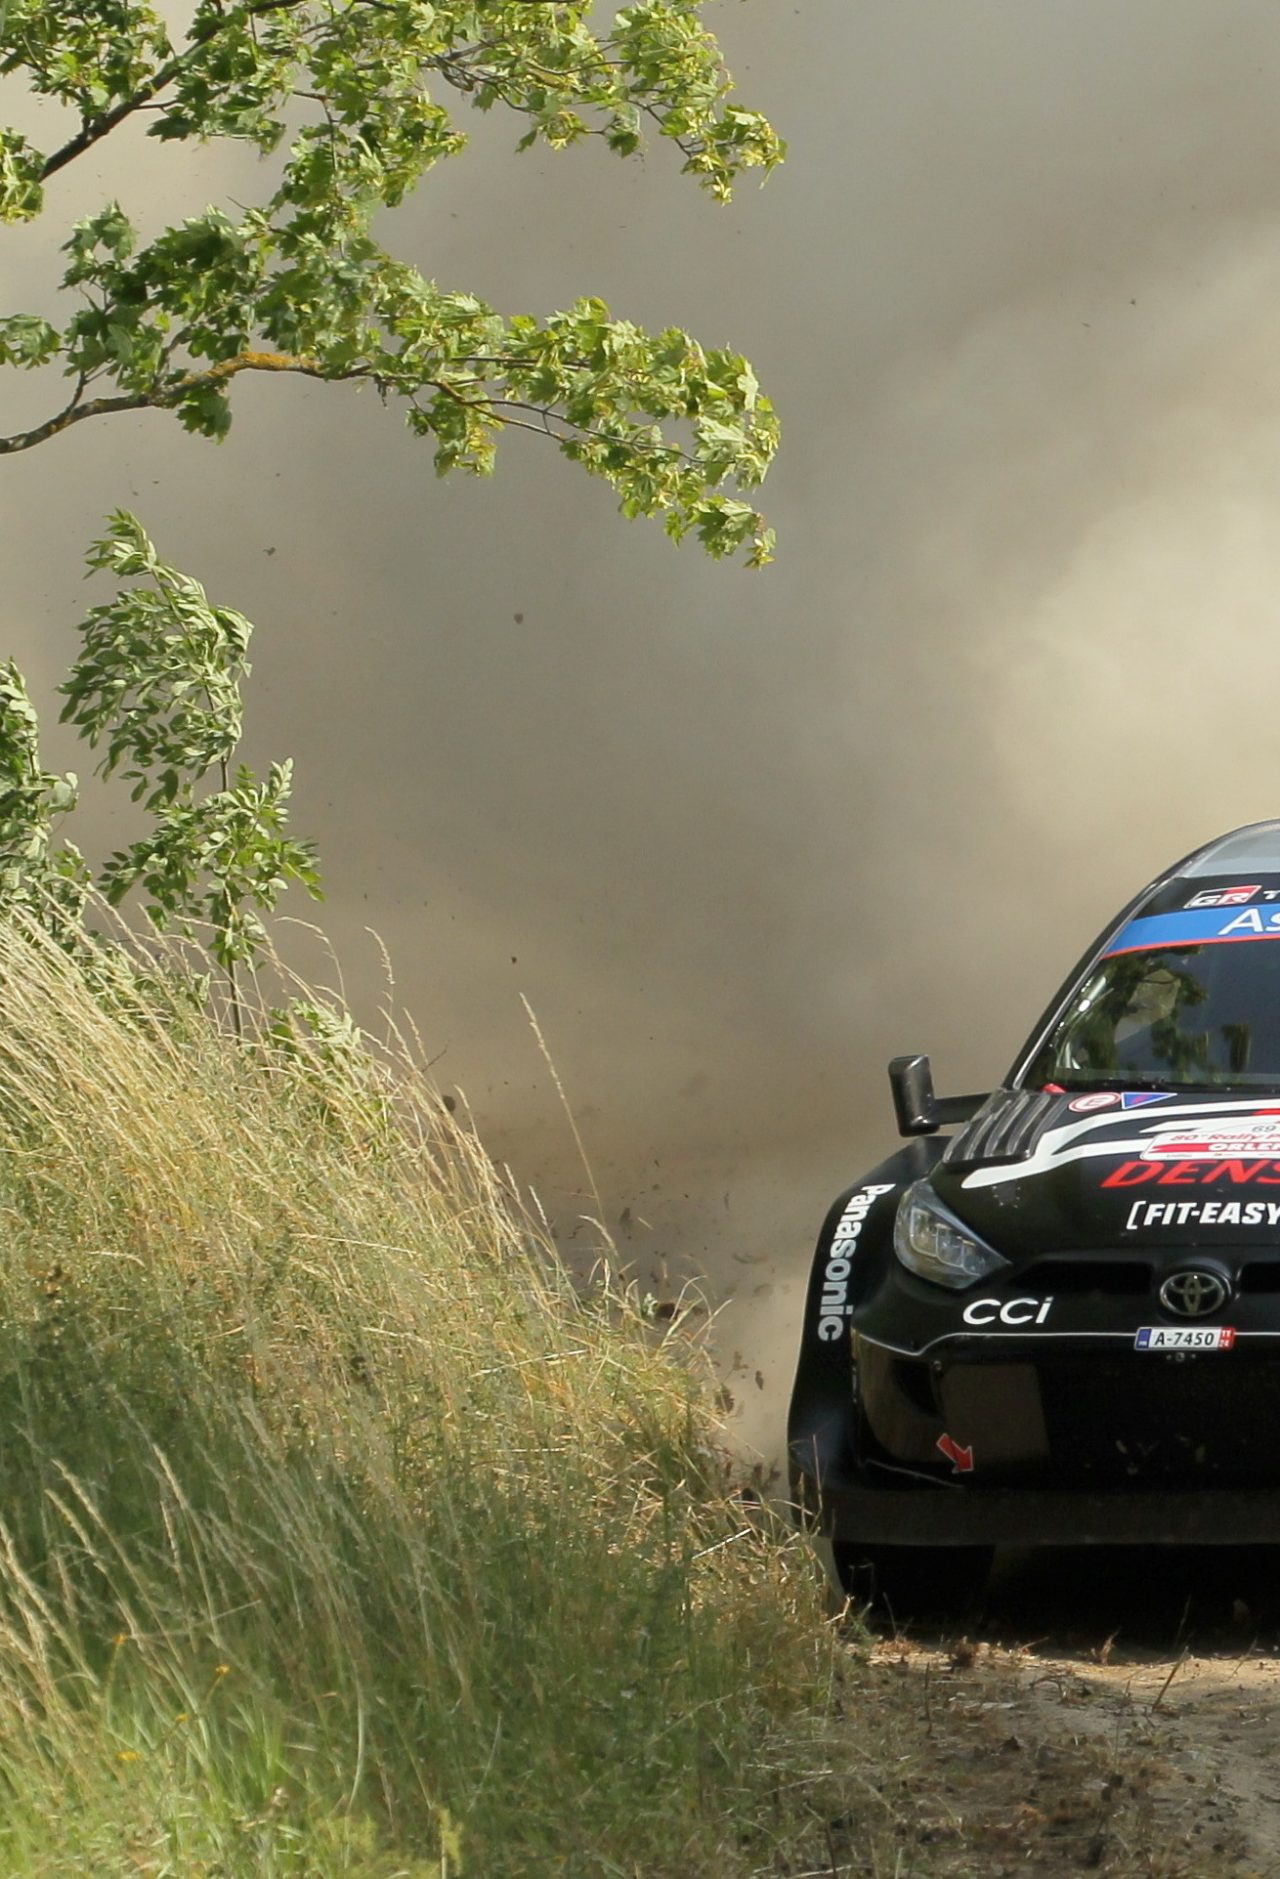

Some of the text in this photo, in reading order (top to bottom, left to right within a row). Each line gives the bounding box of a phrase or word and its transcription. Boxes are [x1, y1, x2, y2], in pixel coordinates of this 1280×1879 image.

[1187, 889, 1252, 908] GR
[817, 1183, 896, 1341] Panasonic
[1154, 1331, 1214, 1346] A-7450
